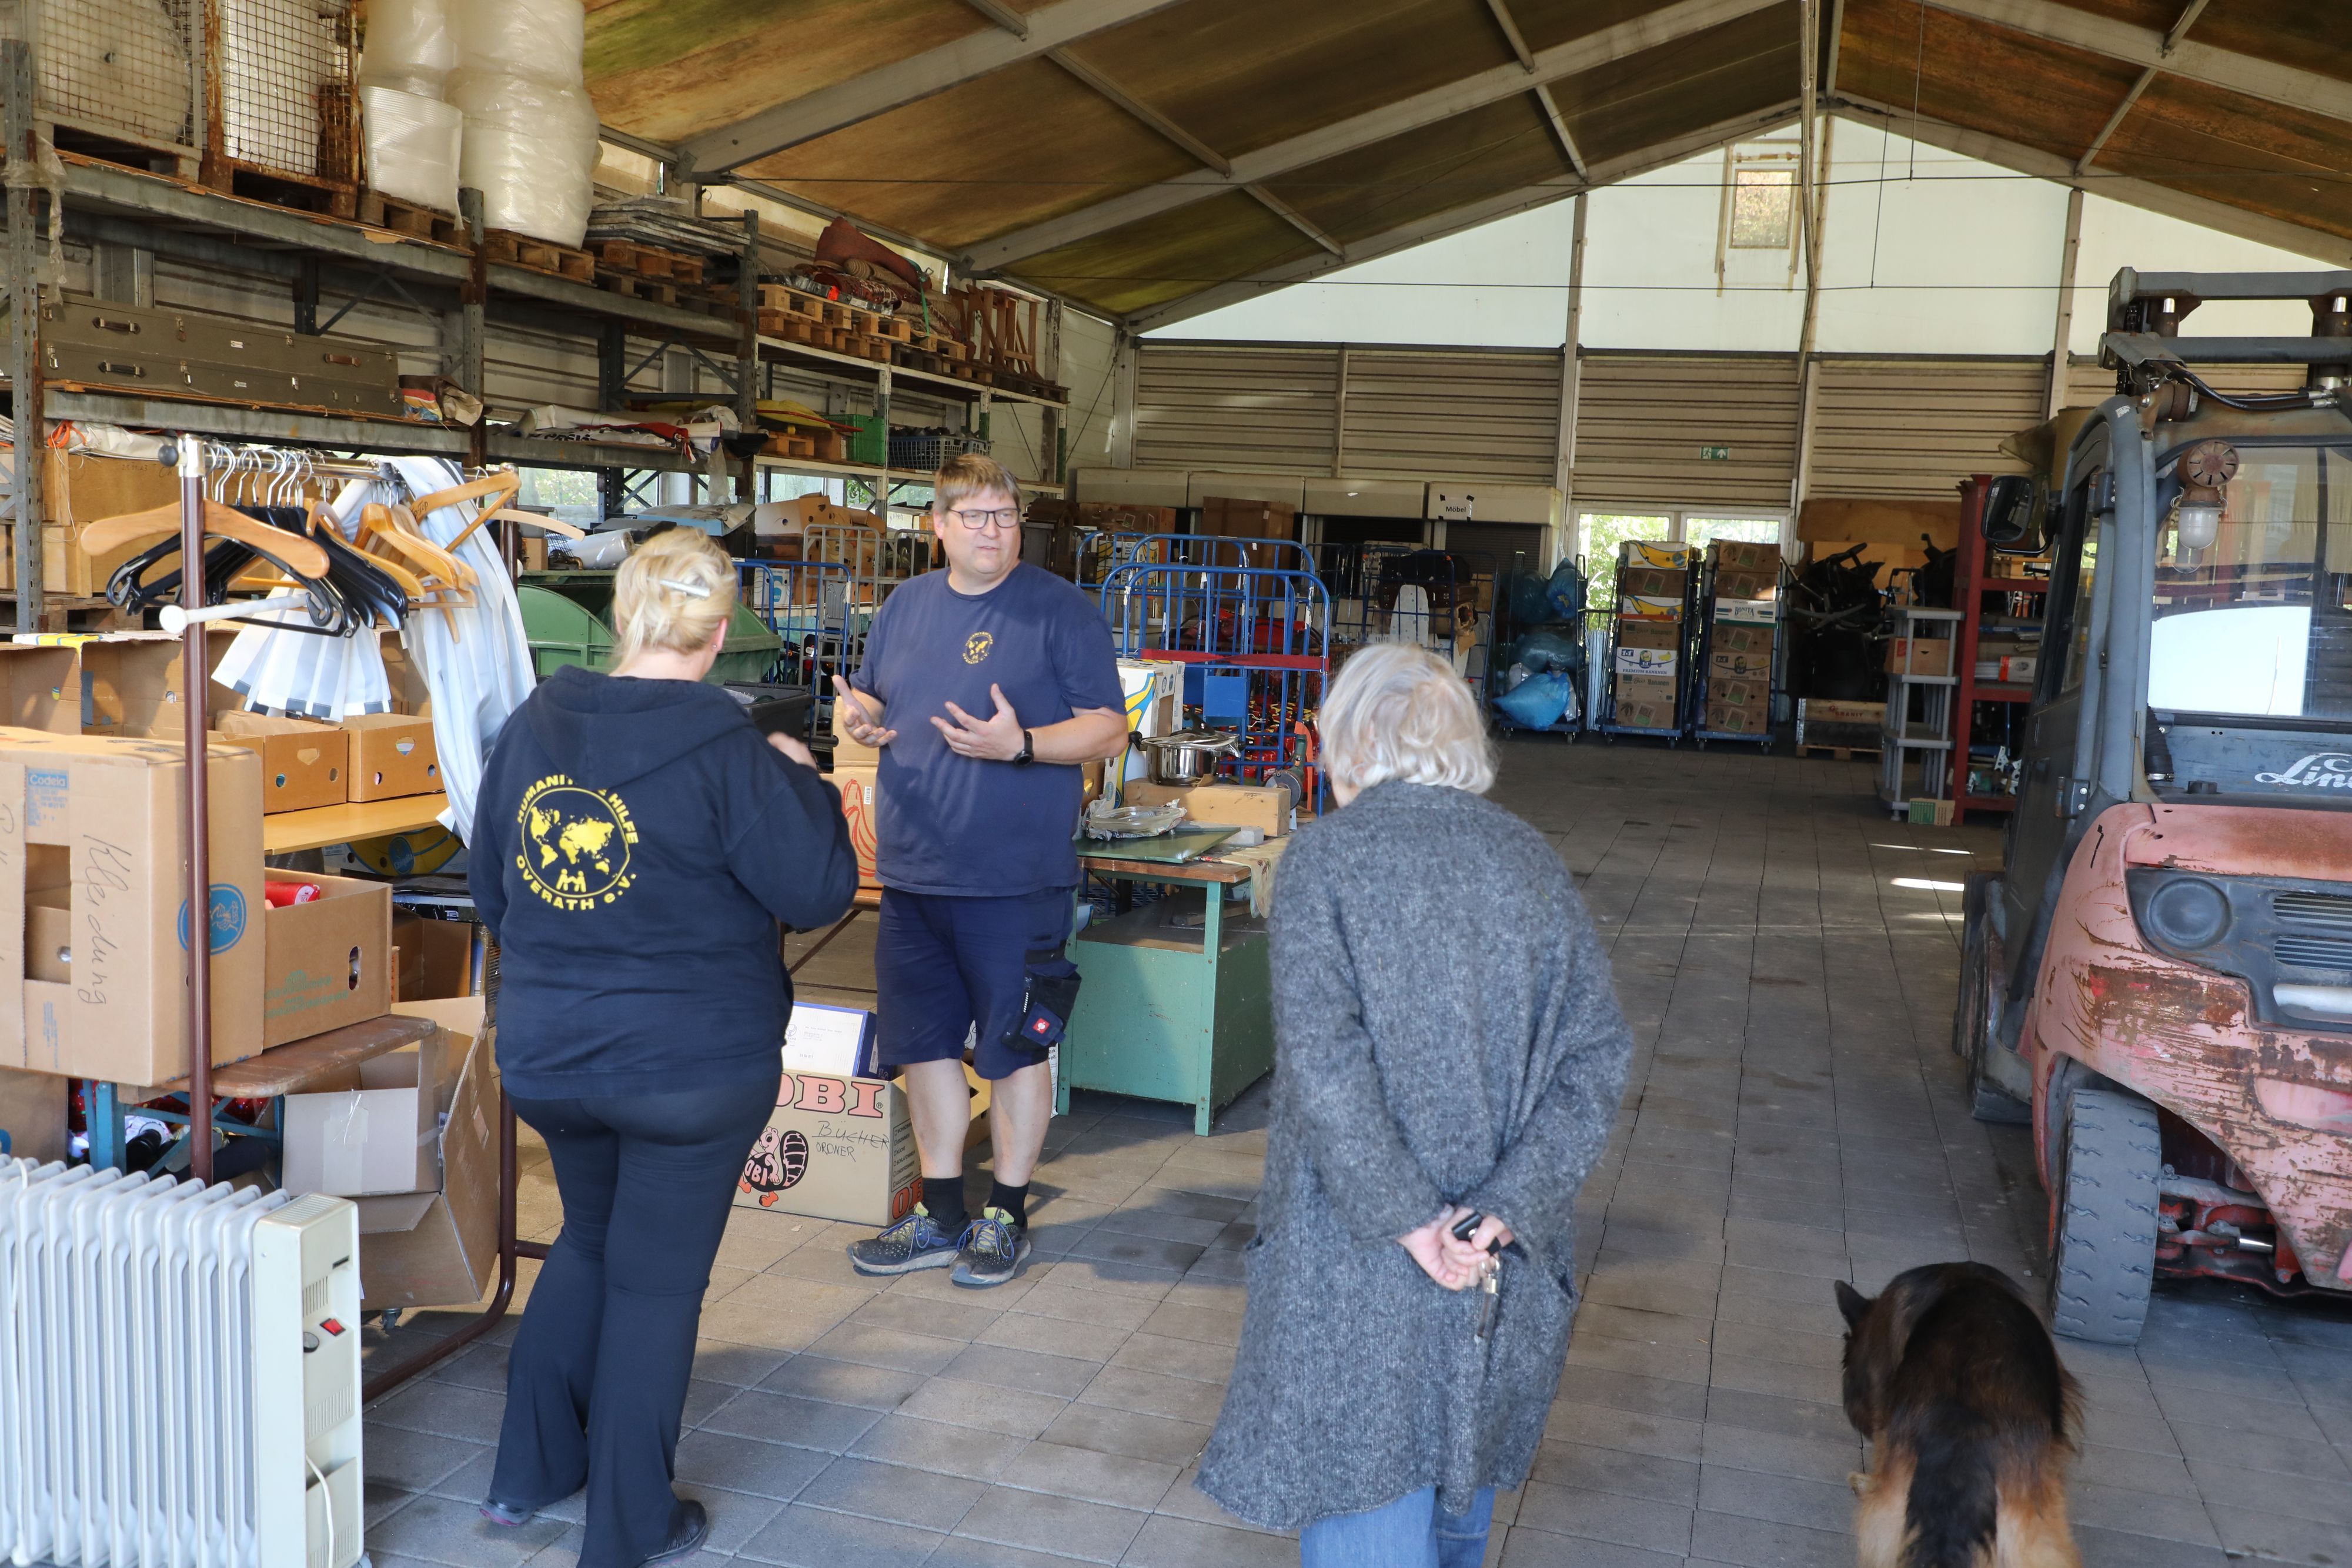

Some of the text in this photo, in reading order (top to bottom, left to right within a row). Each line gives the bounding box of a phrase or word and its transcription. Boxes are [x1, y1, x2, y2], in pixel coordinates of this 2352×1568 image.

[1735, 606, 1754, 616] BONITA
[2254, 753, 2352, 789] Lin
[609, 793, 639, 844] HILFE
[516, 854, 637, 911] OVERATH e.V.
[816, 1141, 856, 1162] ORDNER
[744, 1159, 768, 1186] OBI
[892, 1176, 924, 1220] OB
